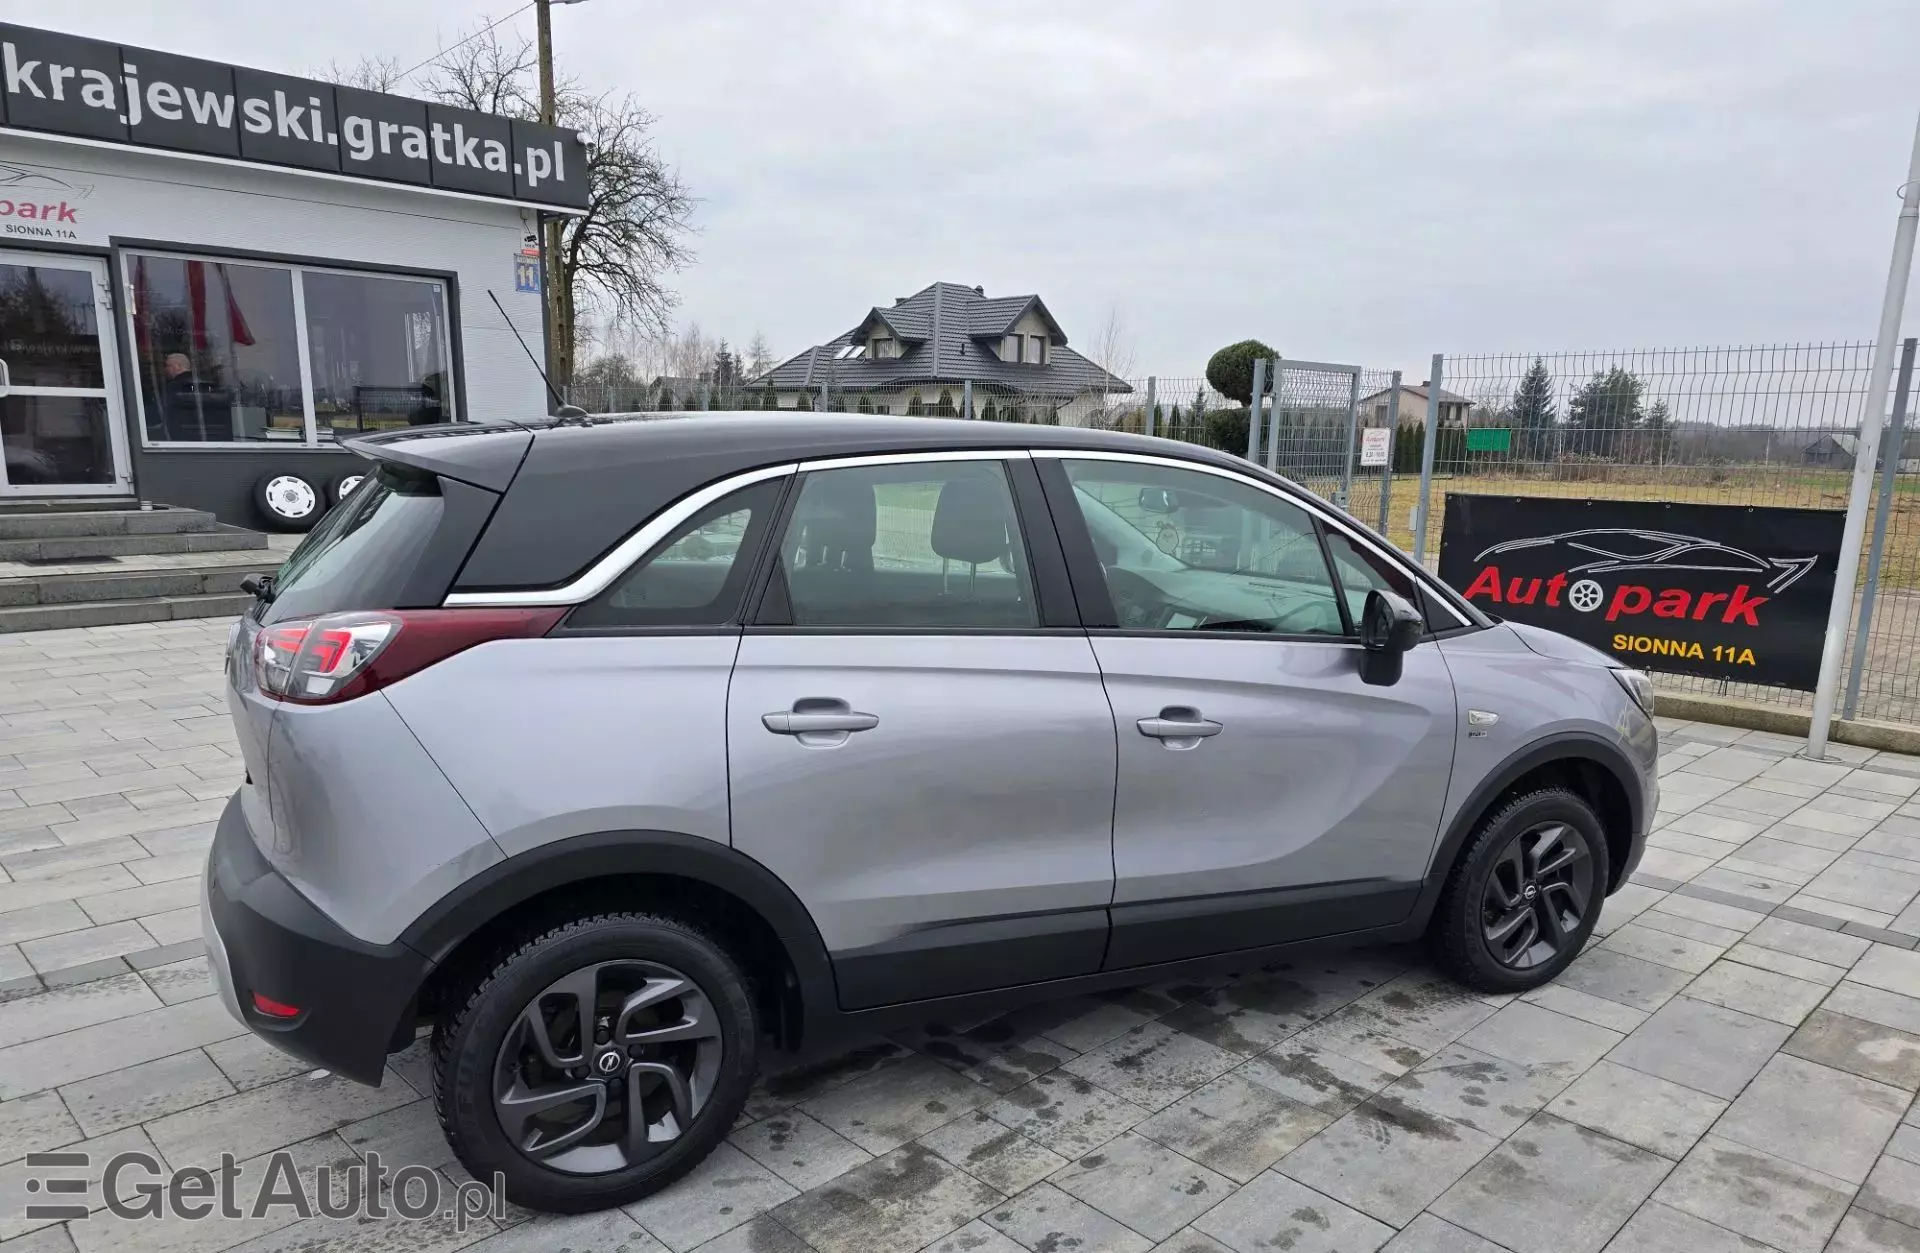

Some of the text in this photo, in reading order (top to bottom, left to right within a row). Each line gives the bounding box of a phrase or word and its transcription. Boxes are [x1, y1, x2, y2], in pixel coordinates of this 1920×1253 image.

[2, 41, 566, 187] krajewski.gratka.pl
[6, 224, 77, 240] SIONNA 11A
[1612, 634, 1757, 666] SIONNA 11A
